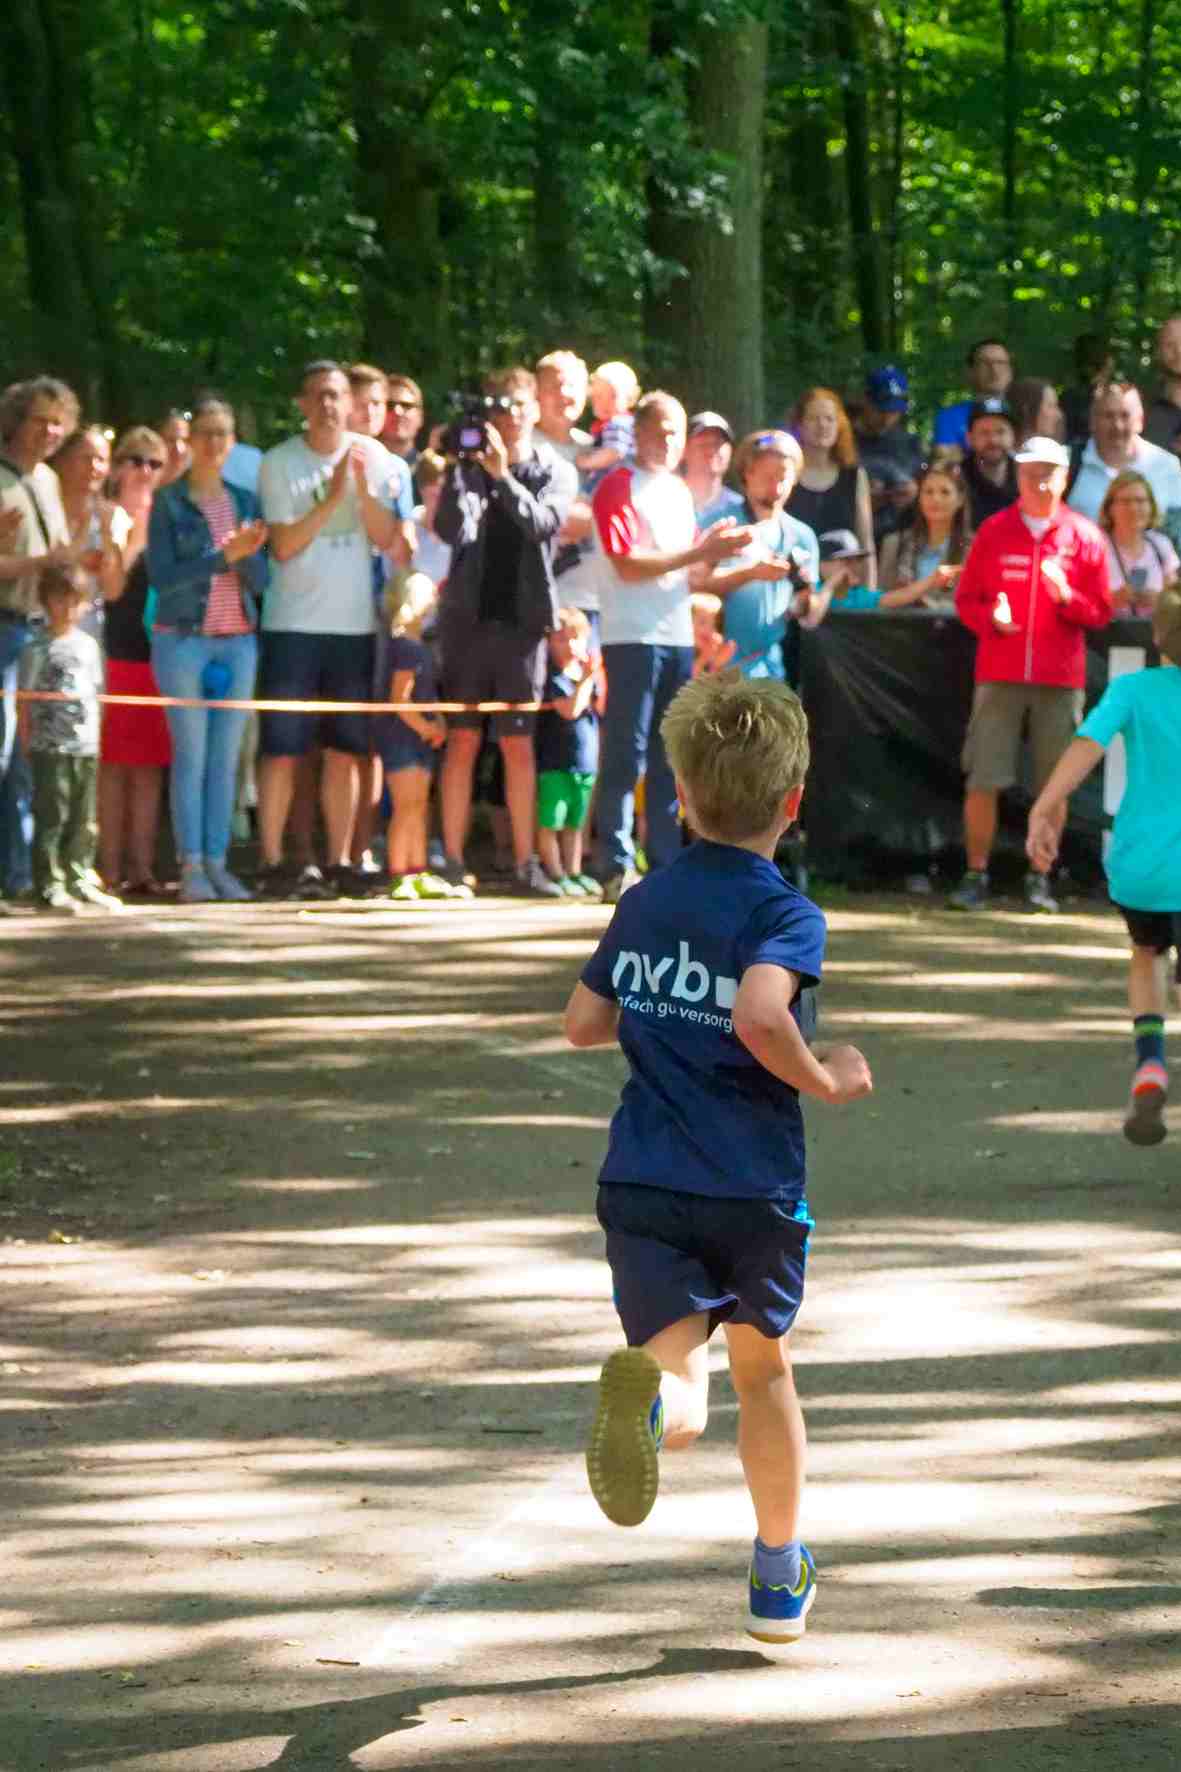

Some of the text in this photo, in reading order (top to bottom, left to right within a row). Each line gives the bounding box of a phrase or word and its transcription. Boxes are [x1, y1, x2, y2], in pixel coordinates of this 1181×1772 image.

[611, 940, 711, 1003] nvb
[657, 1001, 677, 1018] gu
[679, 1006, 736, 1033] versorg
